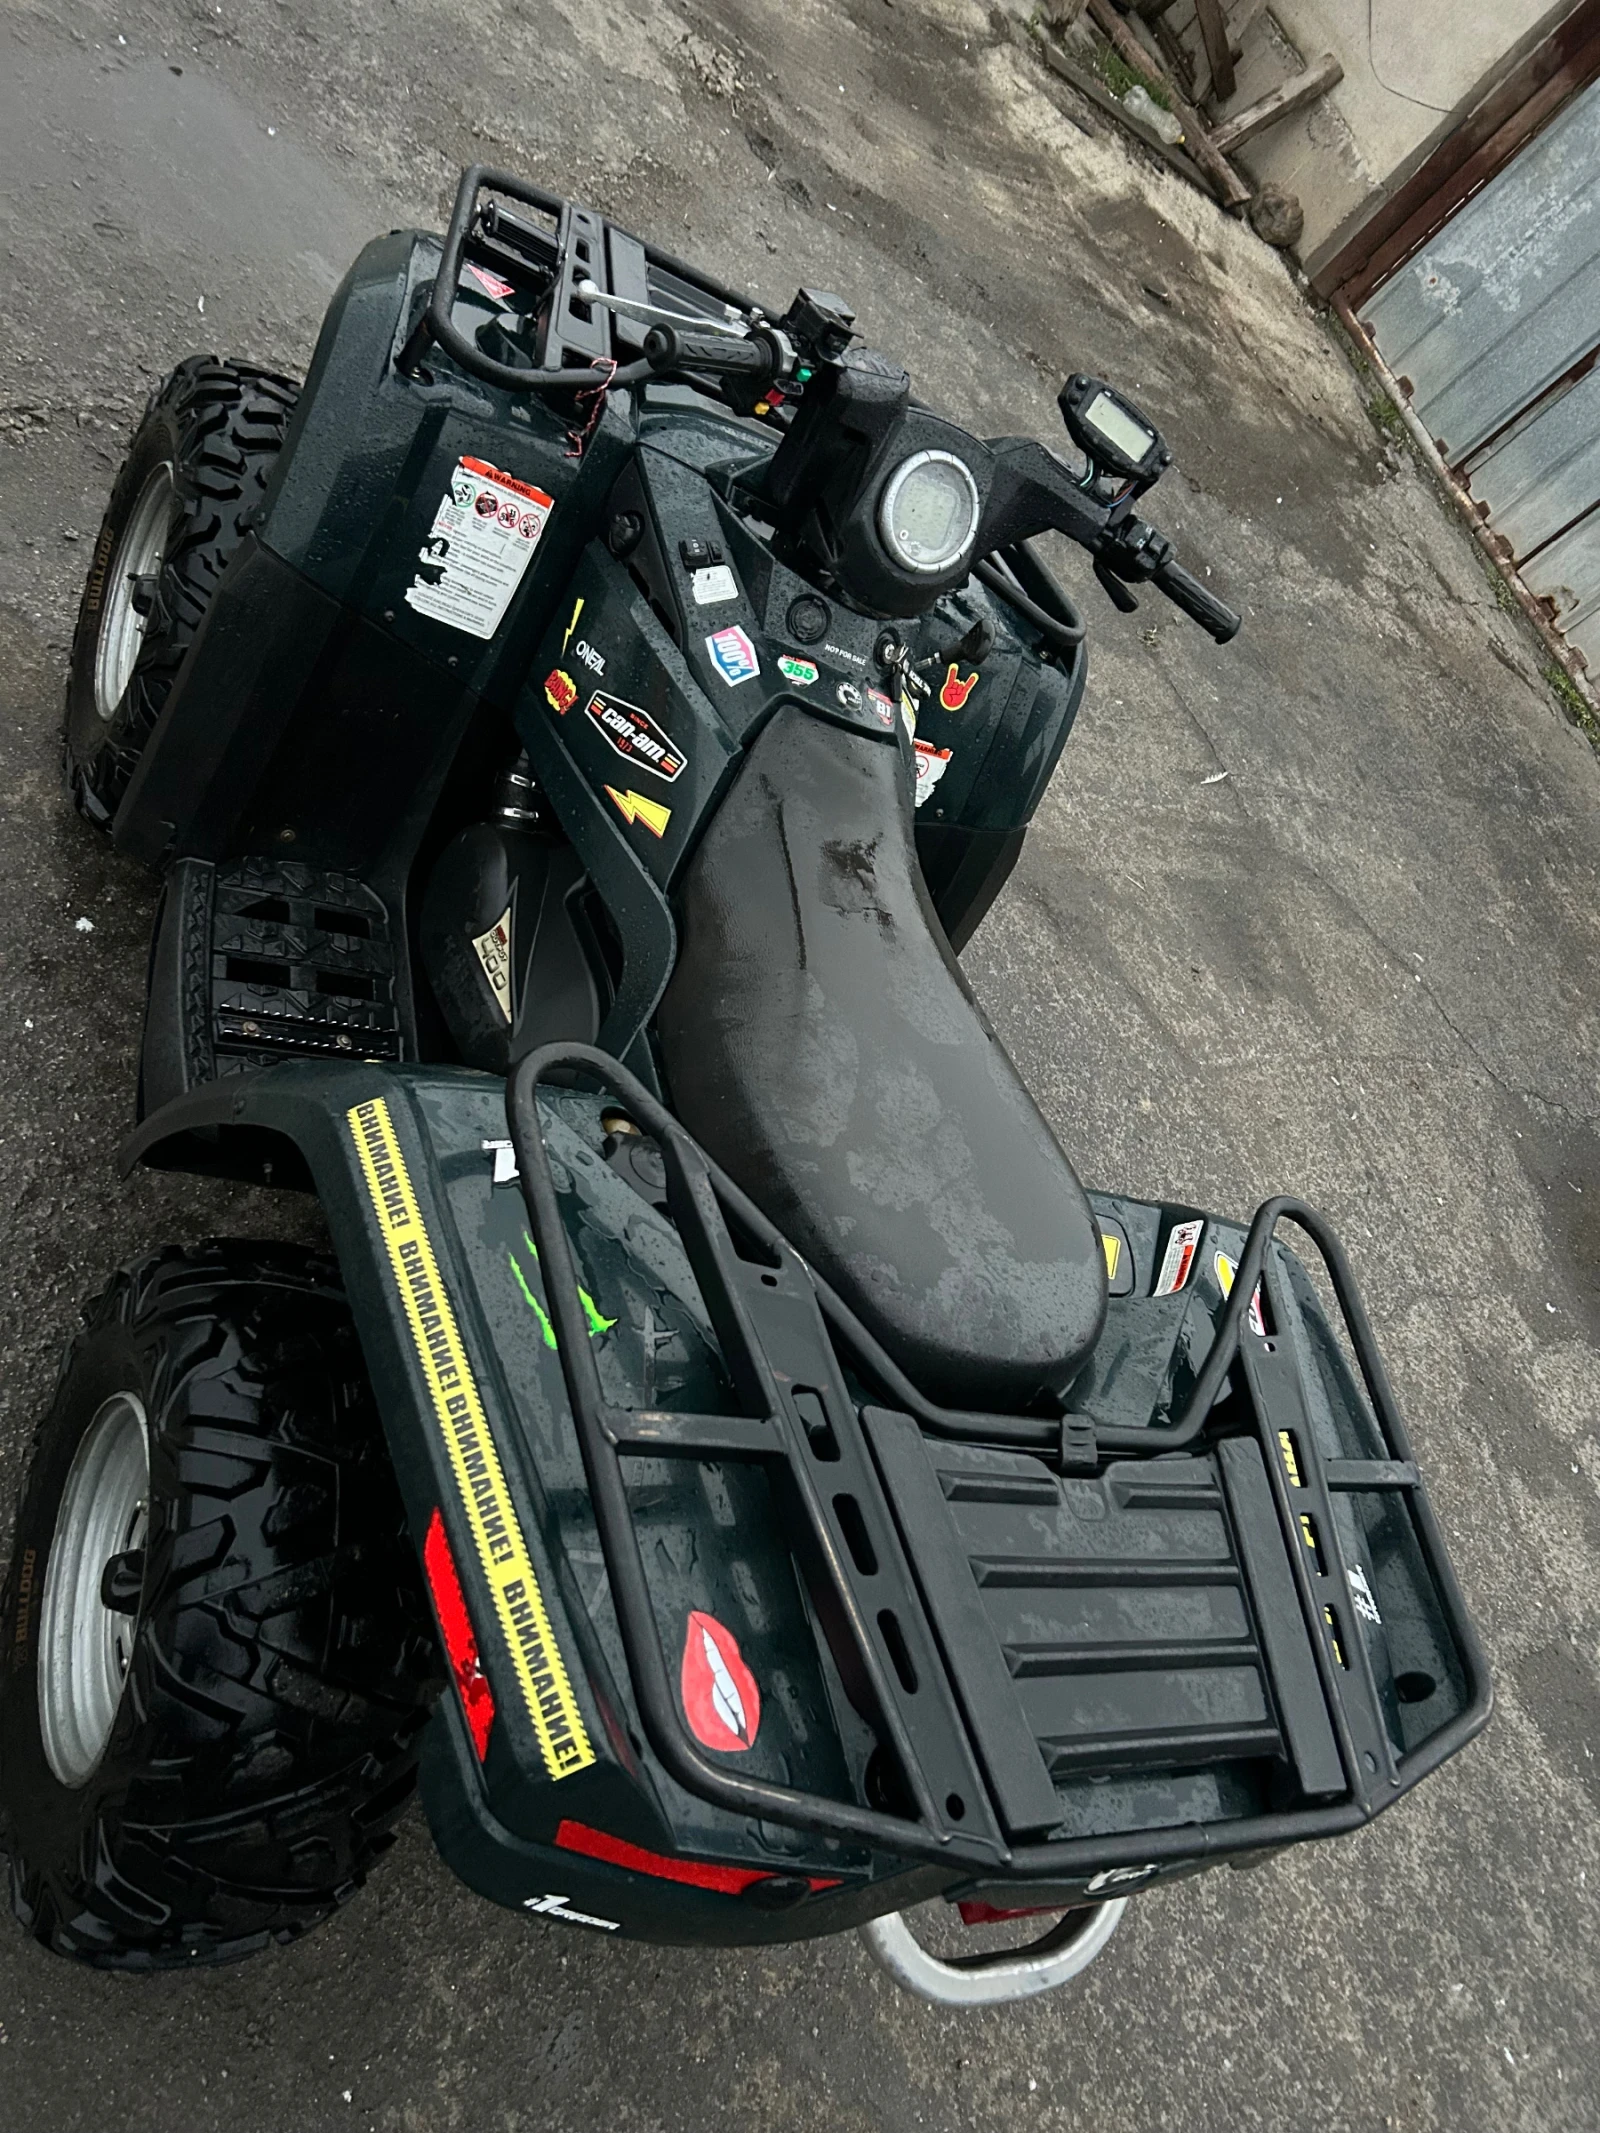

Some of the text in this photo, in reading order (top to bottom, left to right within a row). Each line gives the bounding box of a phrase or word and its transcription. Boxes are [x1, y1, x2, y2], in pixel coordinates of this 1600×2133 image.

[493, 474, 531, 497] WARNING
[87, 528, 115, 611] BULLDOG
[716, 632, 753, 677] 100%
[783, 660, 814, 681] 355
[823, 643, 866, 666] NOT FOR SALE
[544, 669, 579, 715] BANG!
[601, 707, 665, 763] can-am
[630, 713, 649, 730] SINCE
[481, 937, 507, 991] 400
[356, 1102, 582, 1771] ВНИМАНИЕ! ВНИМАНИЕ! ВНИМАНИЕ! ВНИМАНИЕ!
